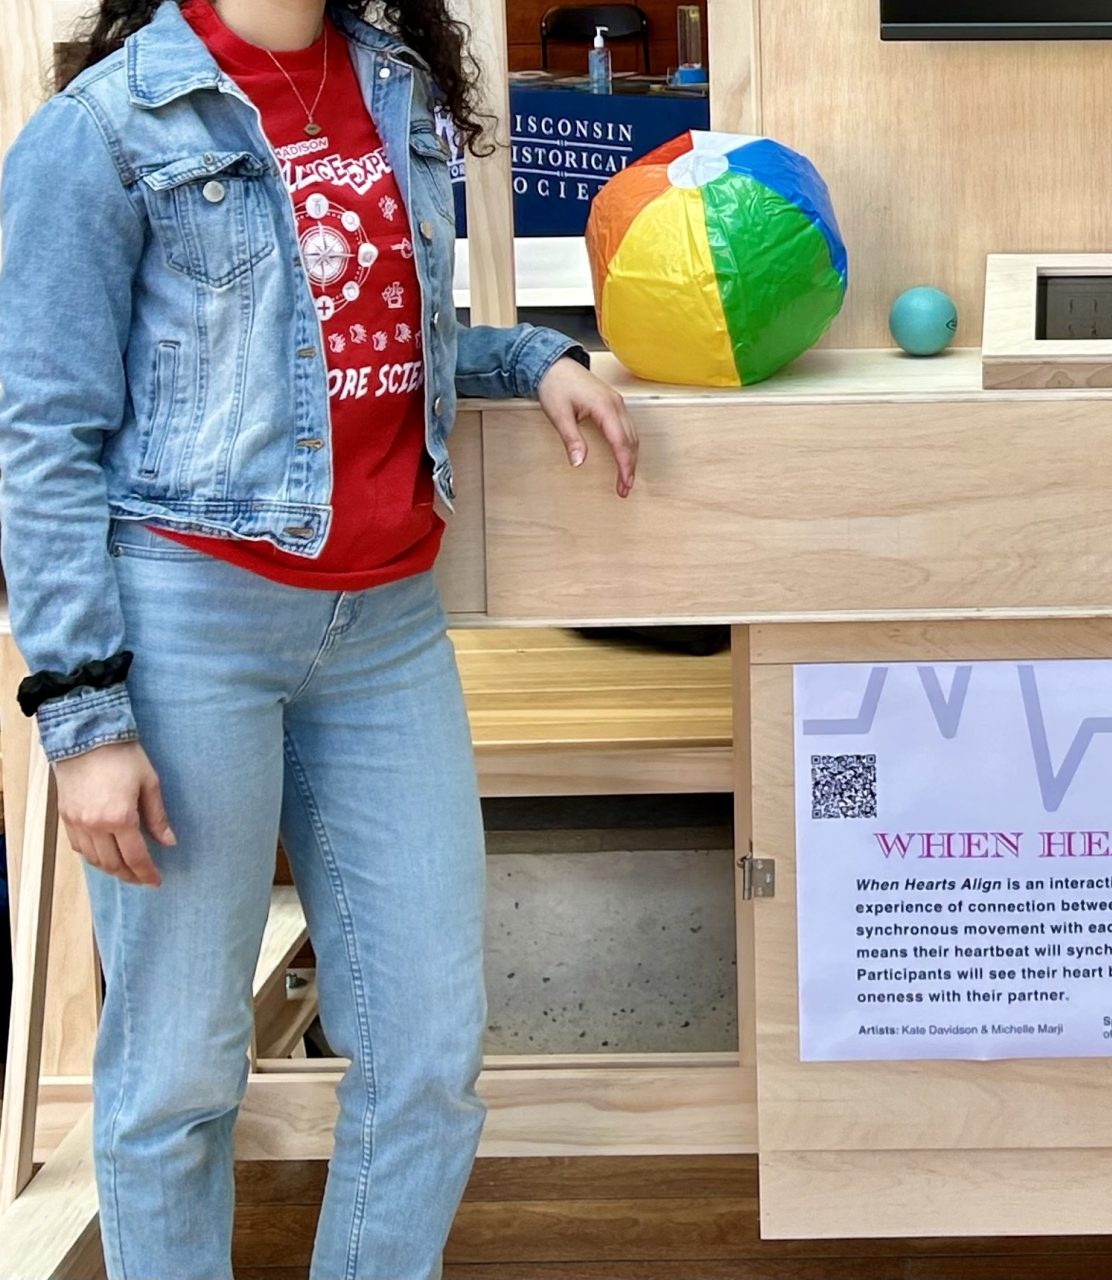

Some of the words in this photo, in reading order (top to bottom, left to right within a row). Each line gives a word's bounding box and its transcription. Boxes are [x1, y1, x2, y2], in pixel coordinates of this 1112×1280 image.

[873, 832, 1023, 859] WHEN
[856, 879, 899, 891] When
[905, 878, 956, 890] Hearts
[960, 878, 1001, 893] Align
[1007, 878, 1020, 890] is
[1026, 880, 1044, 890] an
[856, 900, 943, 916] experience
[948, 900, 963, 913] of
[968, 900, 1055, 913] connection
[856, 923, 958, 939] synchronous
[964, 923, 1045, 935] movement
[1050, 922, 1083, 934] with
[857, 948, 908, 958] means
[913, 945, 949, 958] their
[955, 945, 1029, 957] heartbeat
[1034, 944, 1060, 957] will
[857, 968, 951, 983] Participants
[957, 967, 983, 980] will
[989, 970, 1016, 980] see
[1021, 966, 1057, 979] their
[1063, 966, 1103, 978] heart
[857, 993, 923, 1003] oneness
[928, 990, 961, 1002] with
[967, 989, 1002, 1002] their
[1008, 990, 1069, 1005] partner.
[858, 1025, 899, 1035] Artists:
[902, 1025, 926, 1035] Kate
[929, 1025, 978, 1035] Davidson
[981, 1025, 988, 1034] &
[991, 1024, 1035, 1034] Michelle
[1038, 1024, 1063, 1035] Marji
[1103, 1028, 1112, 1039] of
